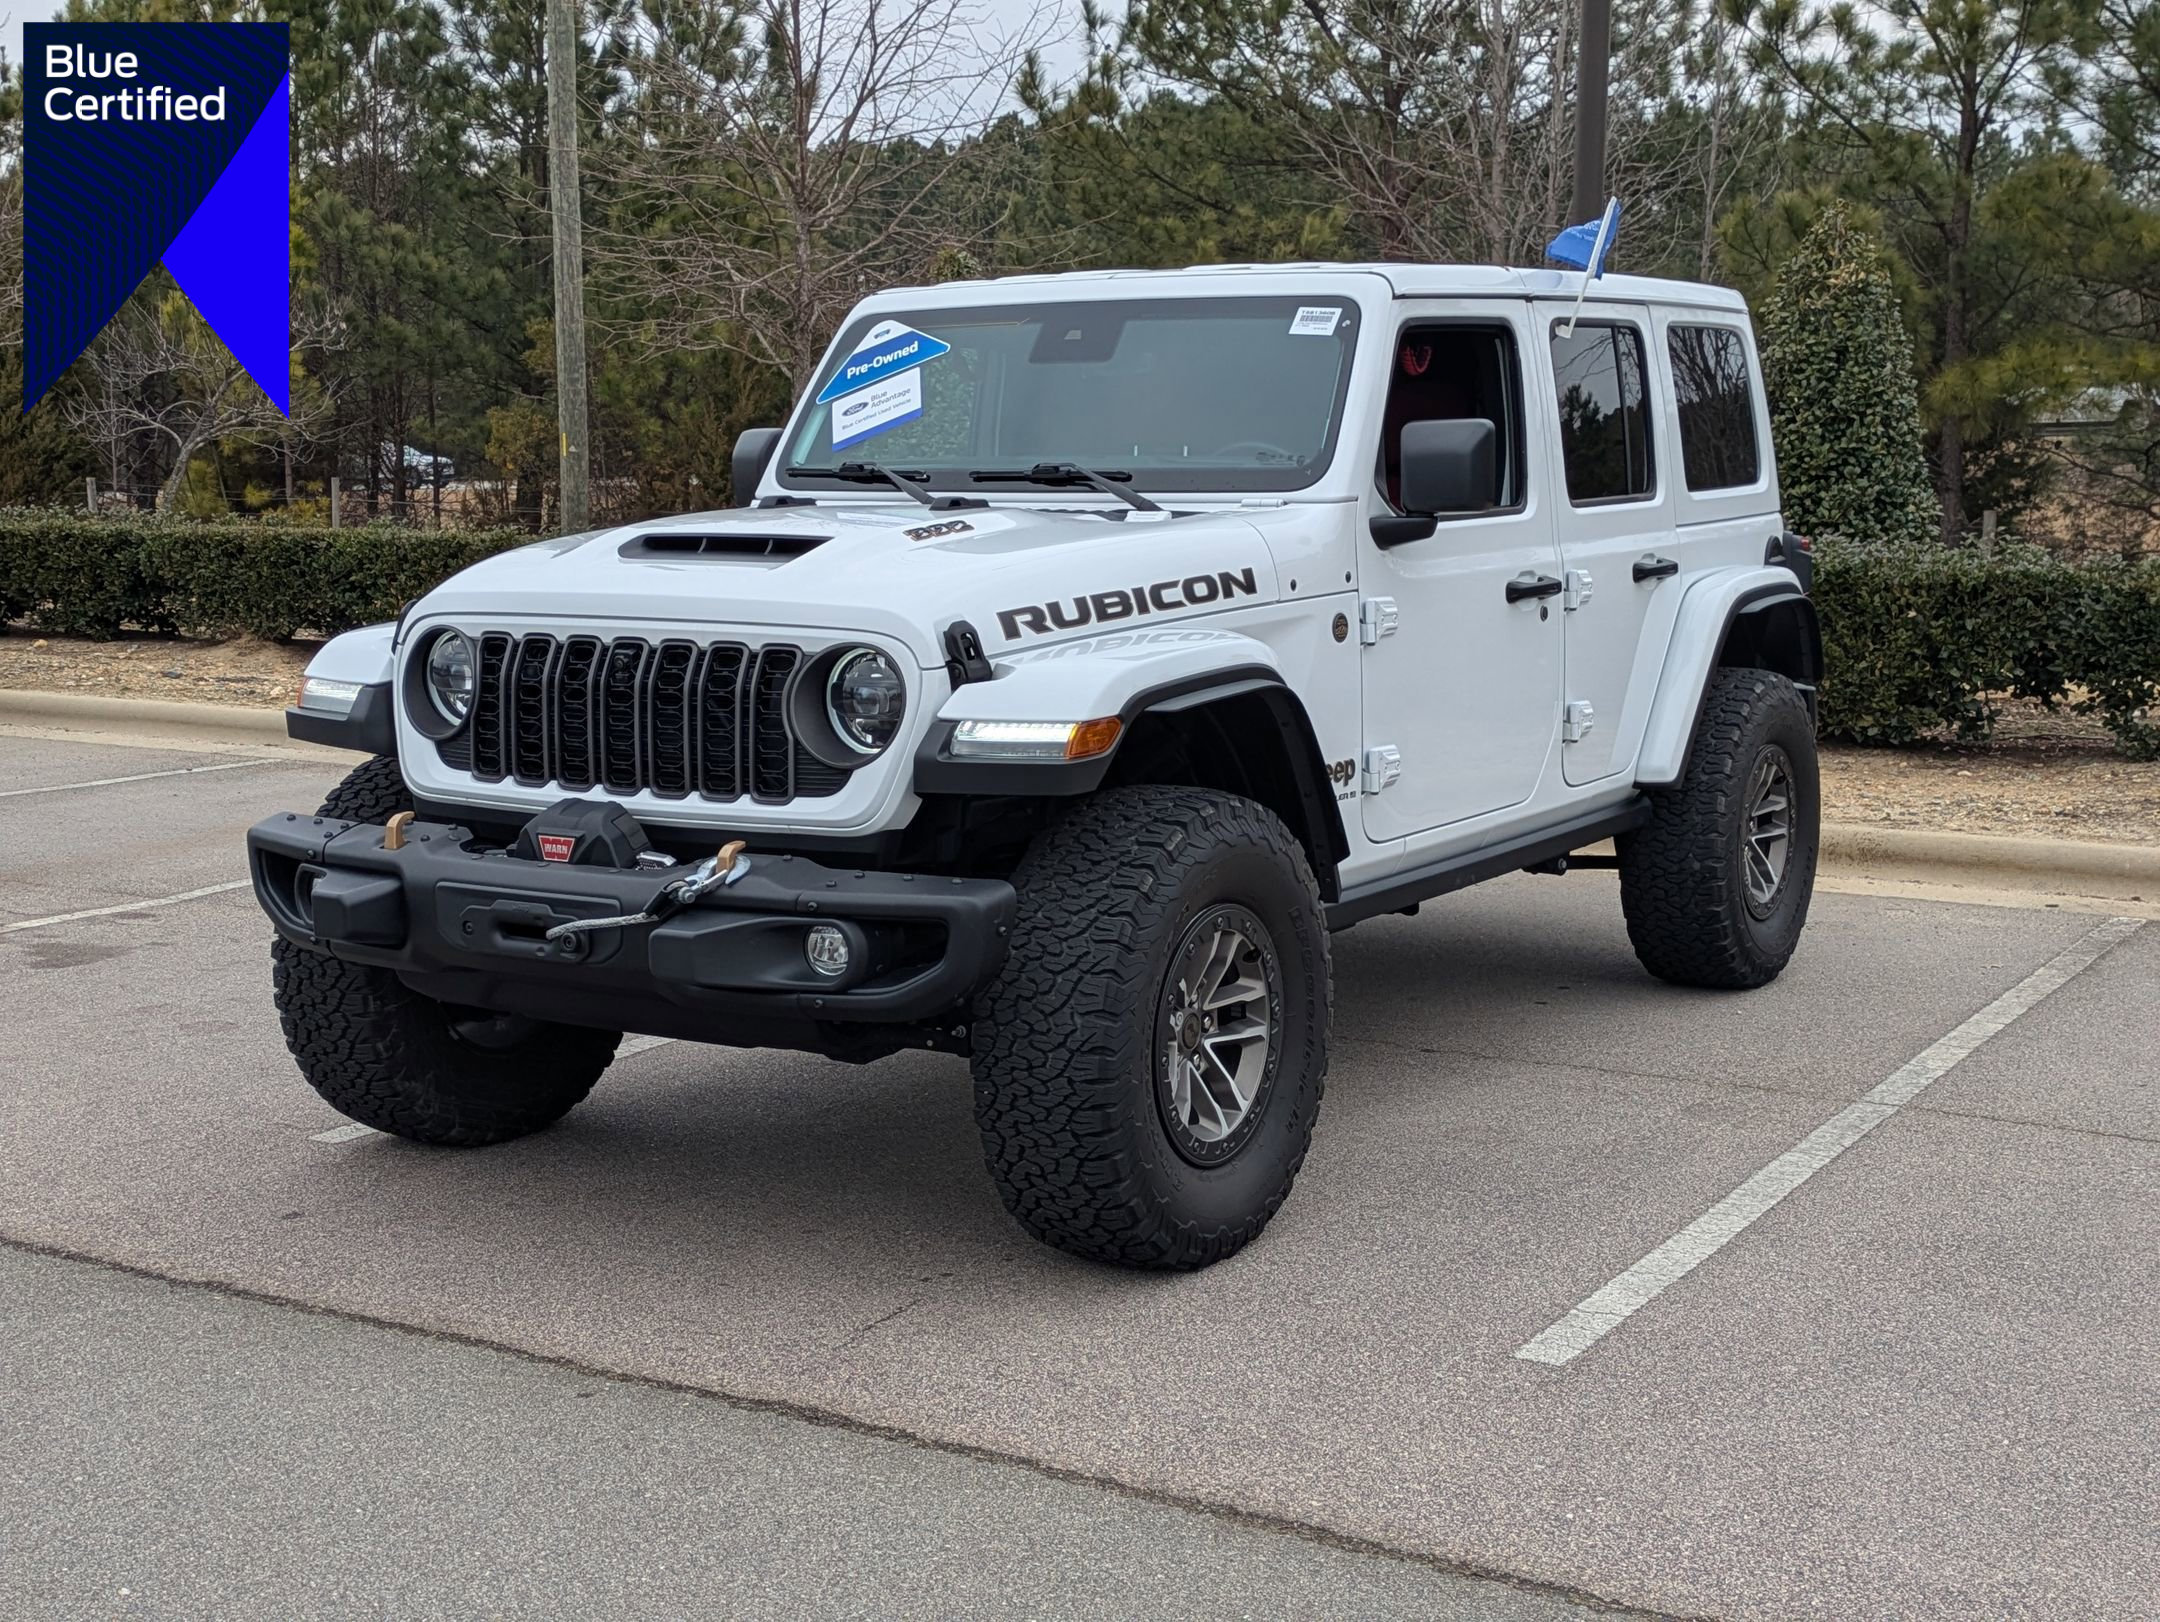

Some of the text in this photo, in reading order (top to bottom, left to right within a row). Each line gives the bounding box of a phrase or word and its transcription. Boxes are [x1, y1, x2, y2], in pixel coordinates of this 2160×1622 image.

[847, 340, 919, 380] Pre-Owned
[870, 391, 888, 402] Blue
[871, 388, 911, 408] Advantage
[996, 567, 1258, 641] RUBICON
[1325, 758, 1356, 787] eep
[544, 843, 568, 855] WARN
